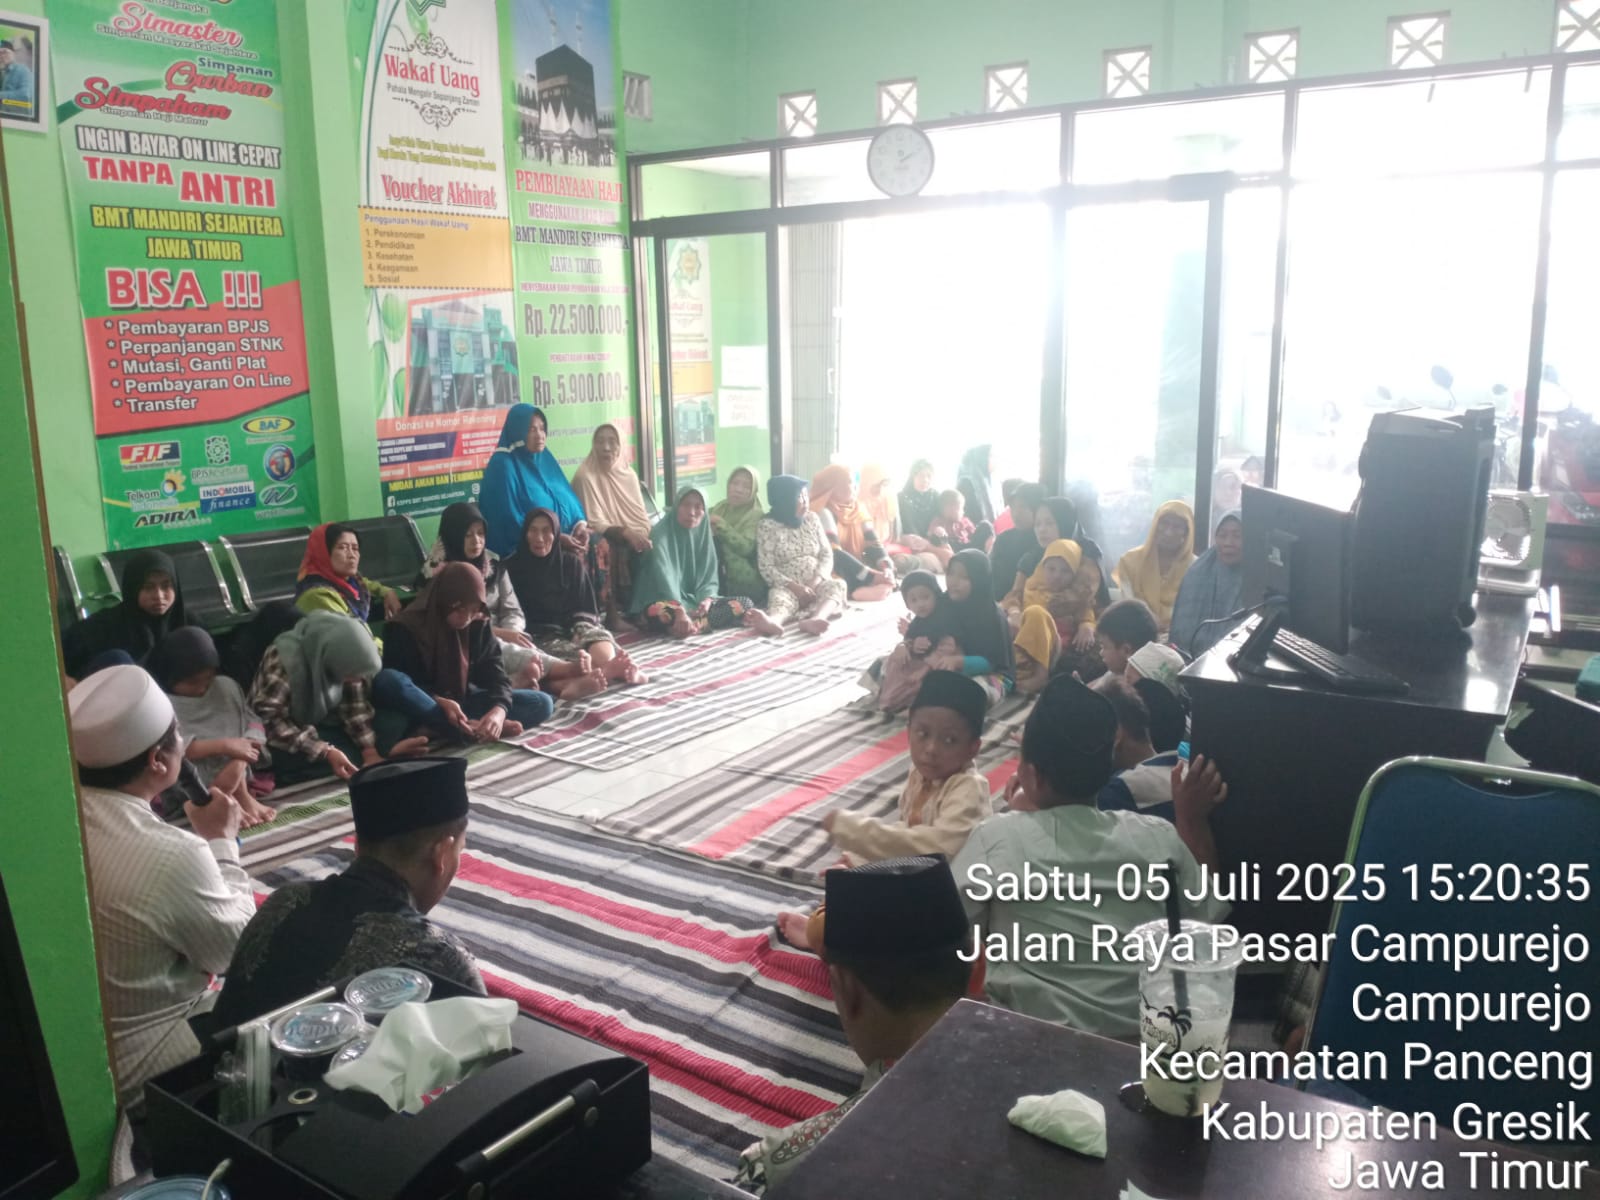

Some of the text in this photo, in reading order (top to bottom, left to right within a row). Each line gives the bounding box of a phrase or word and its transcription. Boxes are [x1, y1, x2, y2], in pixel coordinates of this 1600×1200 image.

[112, 1, 244, 48] Simaster
[198, 57, 273, 78] Simpanan
[384, 54, 480, 98] Wakaf Uang
[165, 61, 272, 98] Qurban
[76, 125, 280, 168] INGIN BAYAR ON LINE CEPAT
[82, 156, 276, 207] TANPA ANTRI
[381, 174, 498, 209] Voucher Akhirat
[515, 169, 624, 203] PEMBIAYAAN HAJI
[91, 205, 284, 237] BMT MANDIRI SEJAHTERA
[451, 221, 470, 232] Uang
[375, 240, 415, 250] Pendidikan
[515, 225, 537, 242] BMT
[539, 227, 579, 246] MANDIRI
[147, 238, 242, 261] JAWA TIMUR
[105, 267, 262, 309] BISA !!!
[119, 319, 270, 337] Pembayaran BPJS
[524, 303, 547, 338] Rp.
[121, 338, 283, 356] Perpanjangan STNK
[123, 356, 266, 374] Mutasi, Ganti Plat
[125, 375, 291, 394] Pembayaran On Line
[532, 375, 556, 408] Rp.
[127, 396, 198, 413] Transfer
[259, 420, 282, 431] BAF
[127, 491, 160, 501] Telkom
[203, 485, 253, 498] INDOMOBIL
[208, 498, 251, 513] finance
[135, 509, 197, 527] ADIRA
